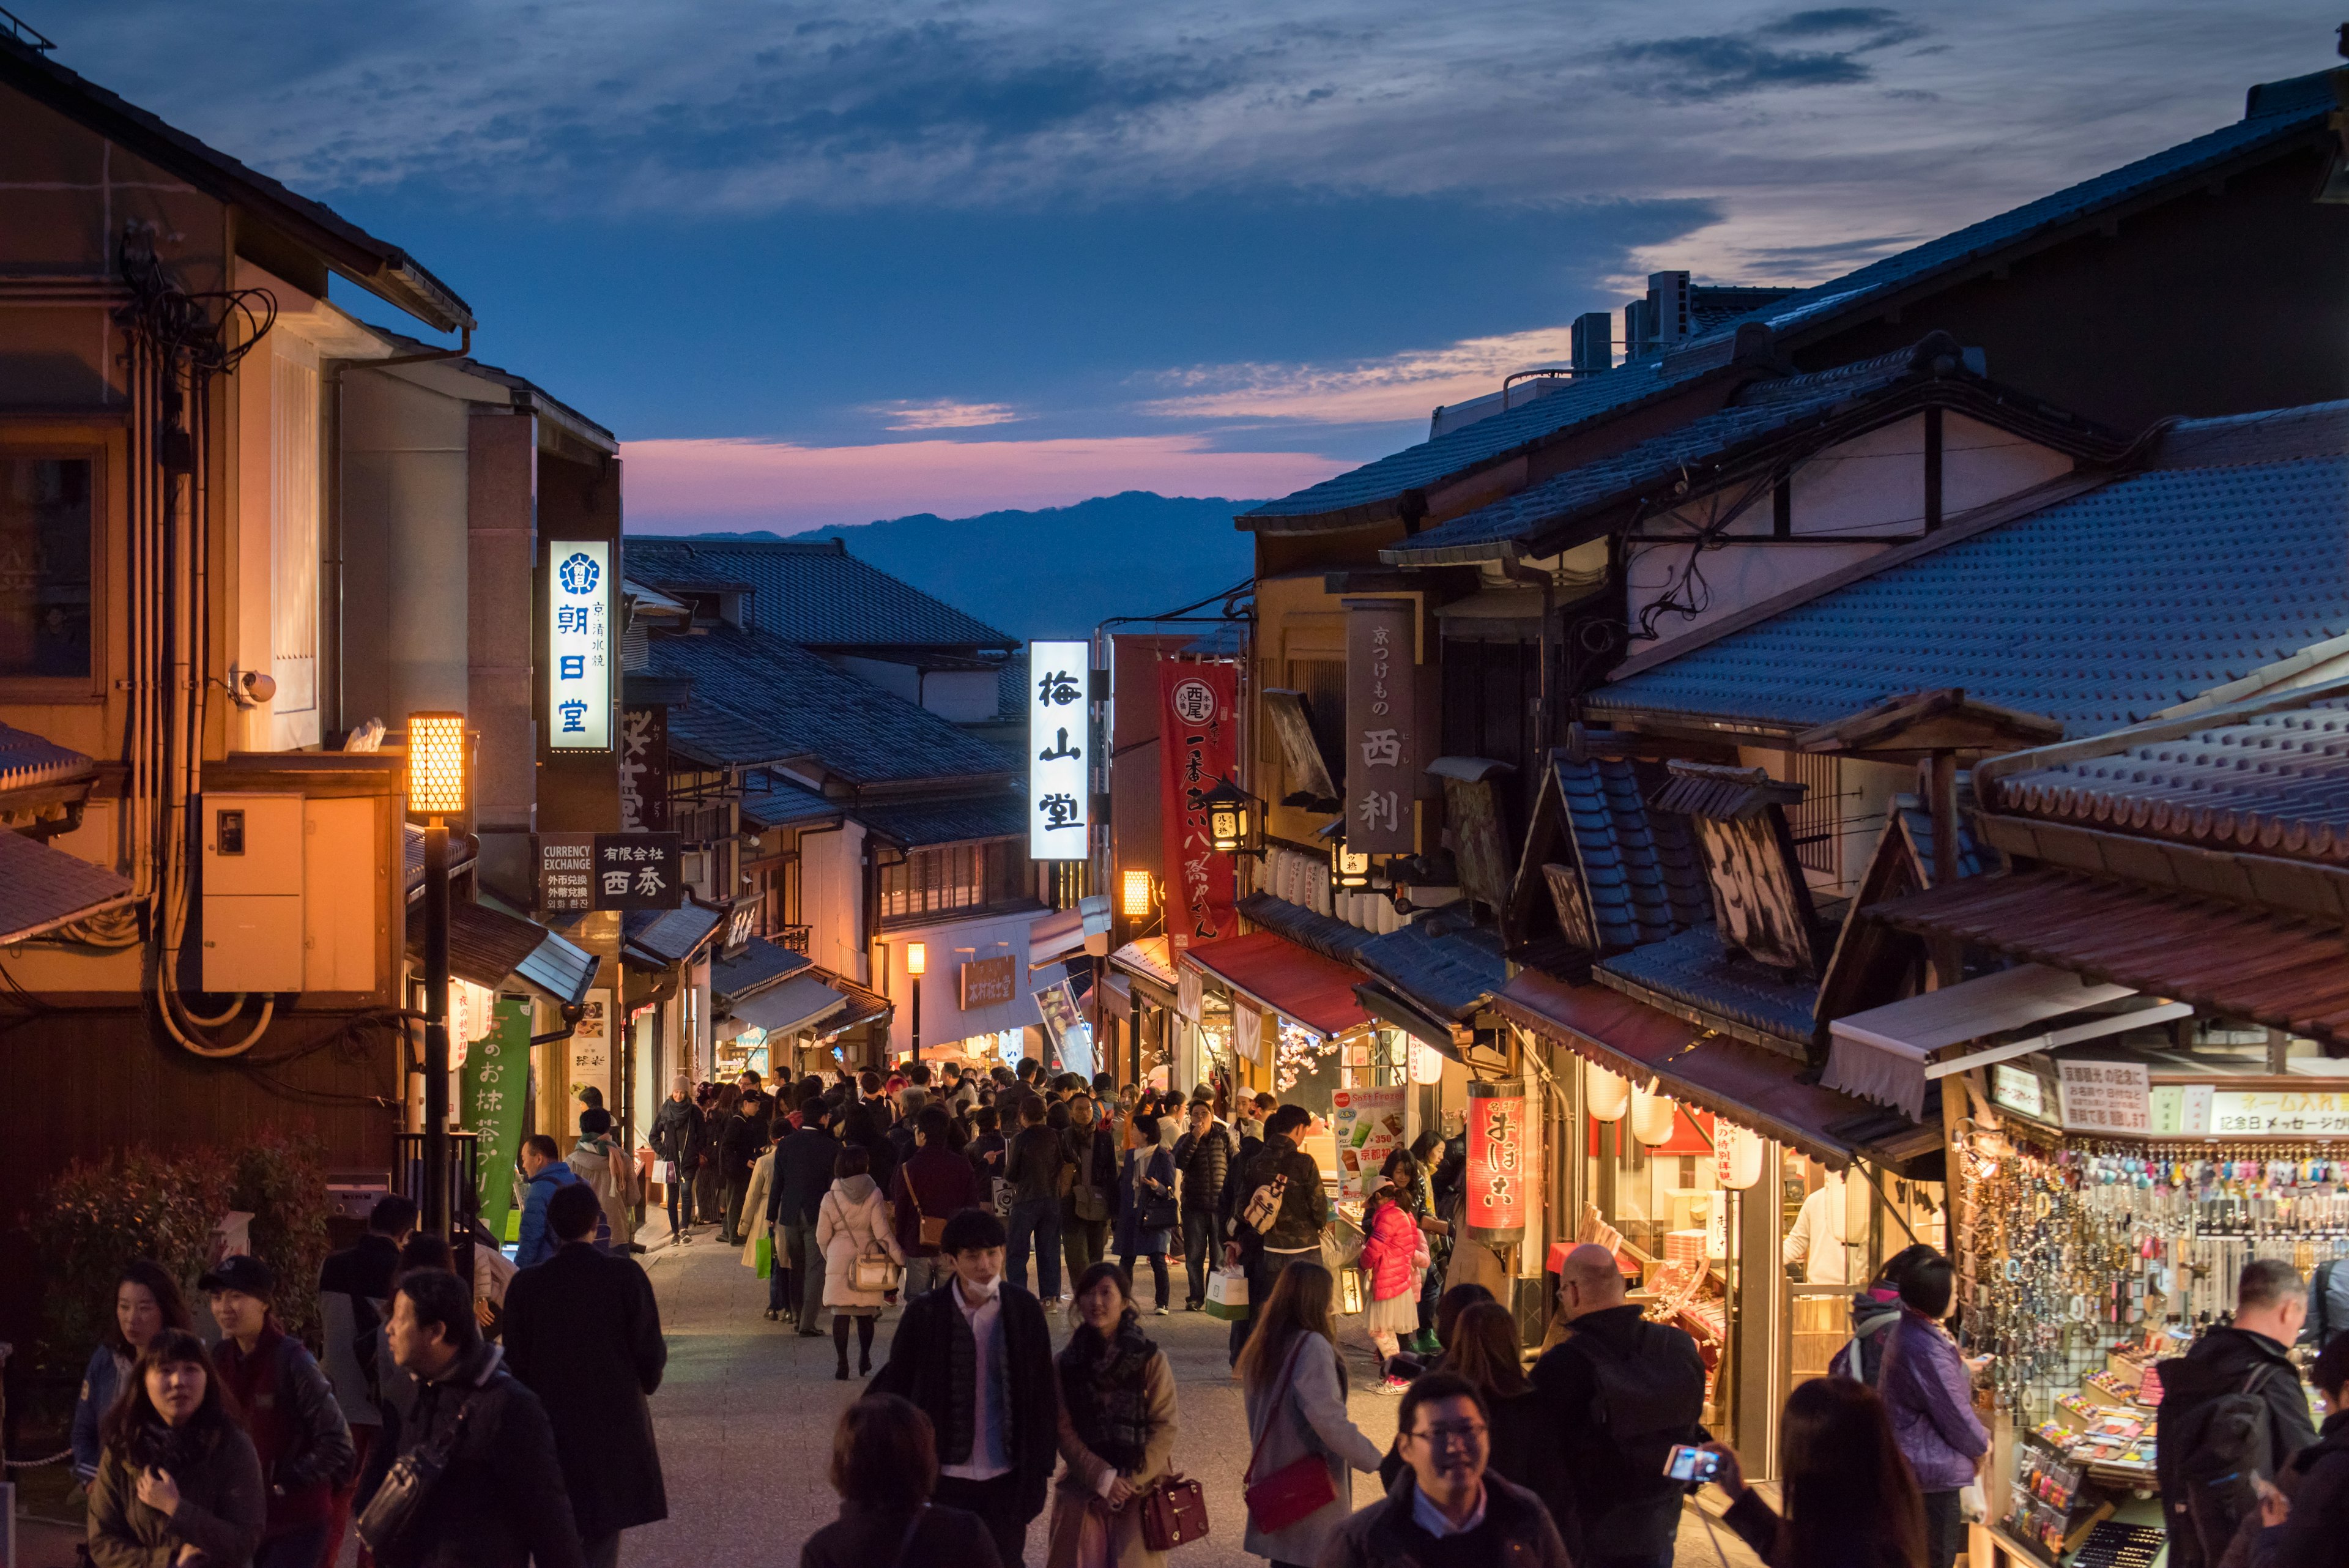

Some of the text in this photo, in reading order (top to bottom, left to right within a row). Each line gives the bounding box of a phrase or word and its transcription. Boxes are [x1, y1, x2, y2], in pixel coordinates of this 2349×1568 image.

[558, 604, 589, 732] 朝日堂
[1372, 626, 1390, 716] 京つけもの
[1186, 686, 1204, 719] 西尾
[1203, 694, 1211, 711] 本家
[1039, 670, 1085, 831] 梅山堂
[1358, 729, 1401, 832] 西利
[544, 846, 590, 857] CURRENCY
[604, 846, 664, 861] 有限会社
[544, 859, 591, 870] EXCHANGE
[602, 866, 667, 896] 西秀
[547, 899, 566, 908] 외화
[1352, 1092, 1405, 1102] Soft Frozen
[1487, 1101, 1515, 1112] 名物
[1375, 1134, 1392, 1143] 350
